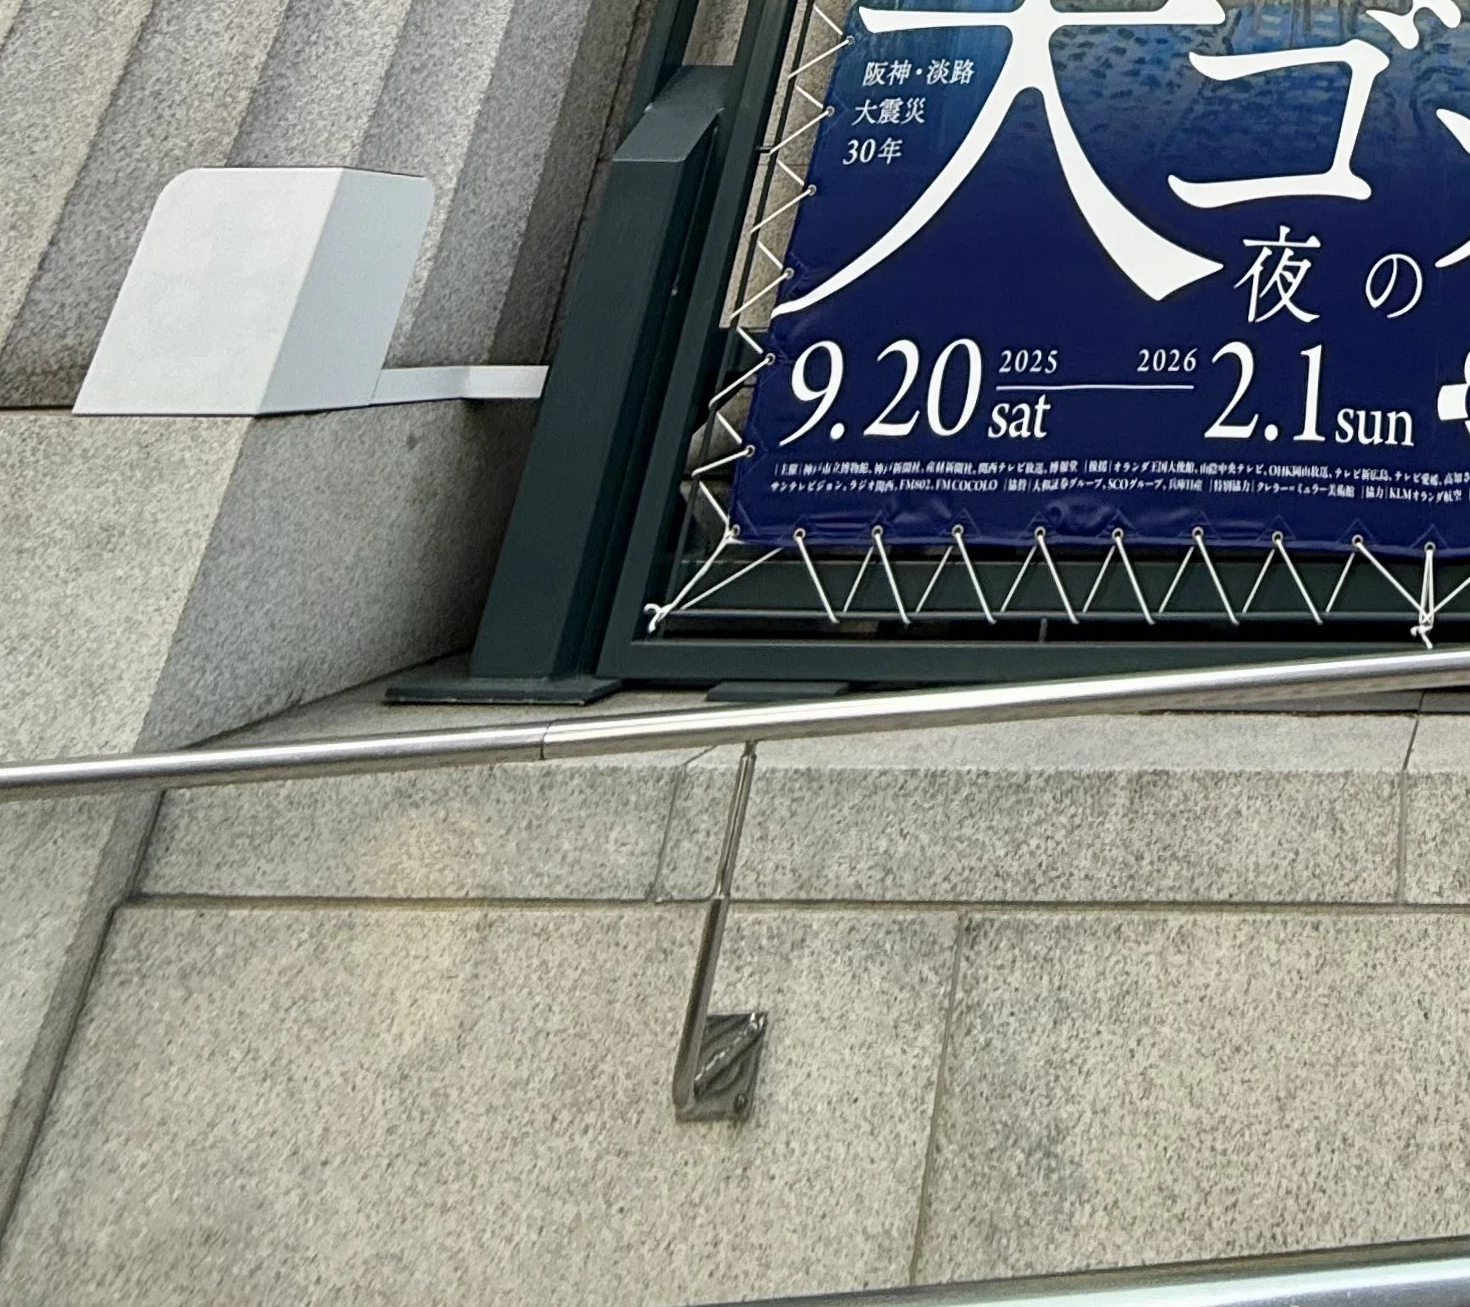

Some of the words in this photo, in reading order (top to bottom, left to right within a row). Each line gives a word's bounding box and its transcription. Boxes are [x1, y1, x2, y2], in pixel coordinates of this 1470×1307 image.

[862, 58, 976, 87] 阪神・淡路
[852, 97, 926, 126] 大震災
[842, 137, 903, 166] 30年
[999, 348, 1059, 375] 2025
[1136, 347, 1198, 373] 2026
[779, 338, 982, 447] 9.20
[1204, 341, 1326, 443] 2.1
[987, 393, 1052, 439] sat
[1335, 407, 1414, 447] sun
